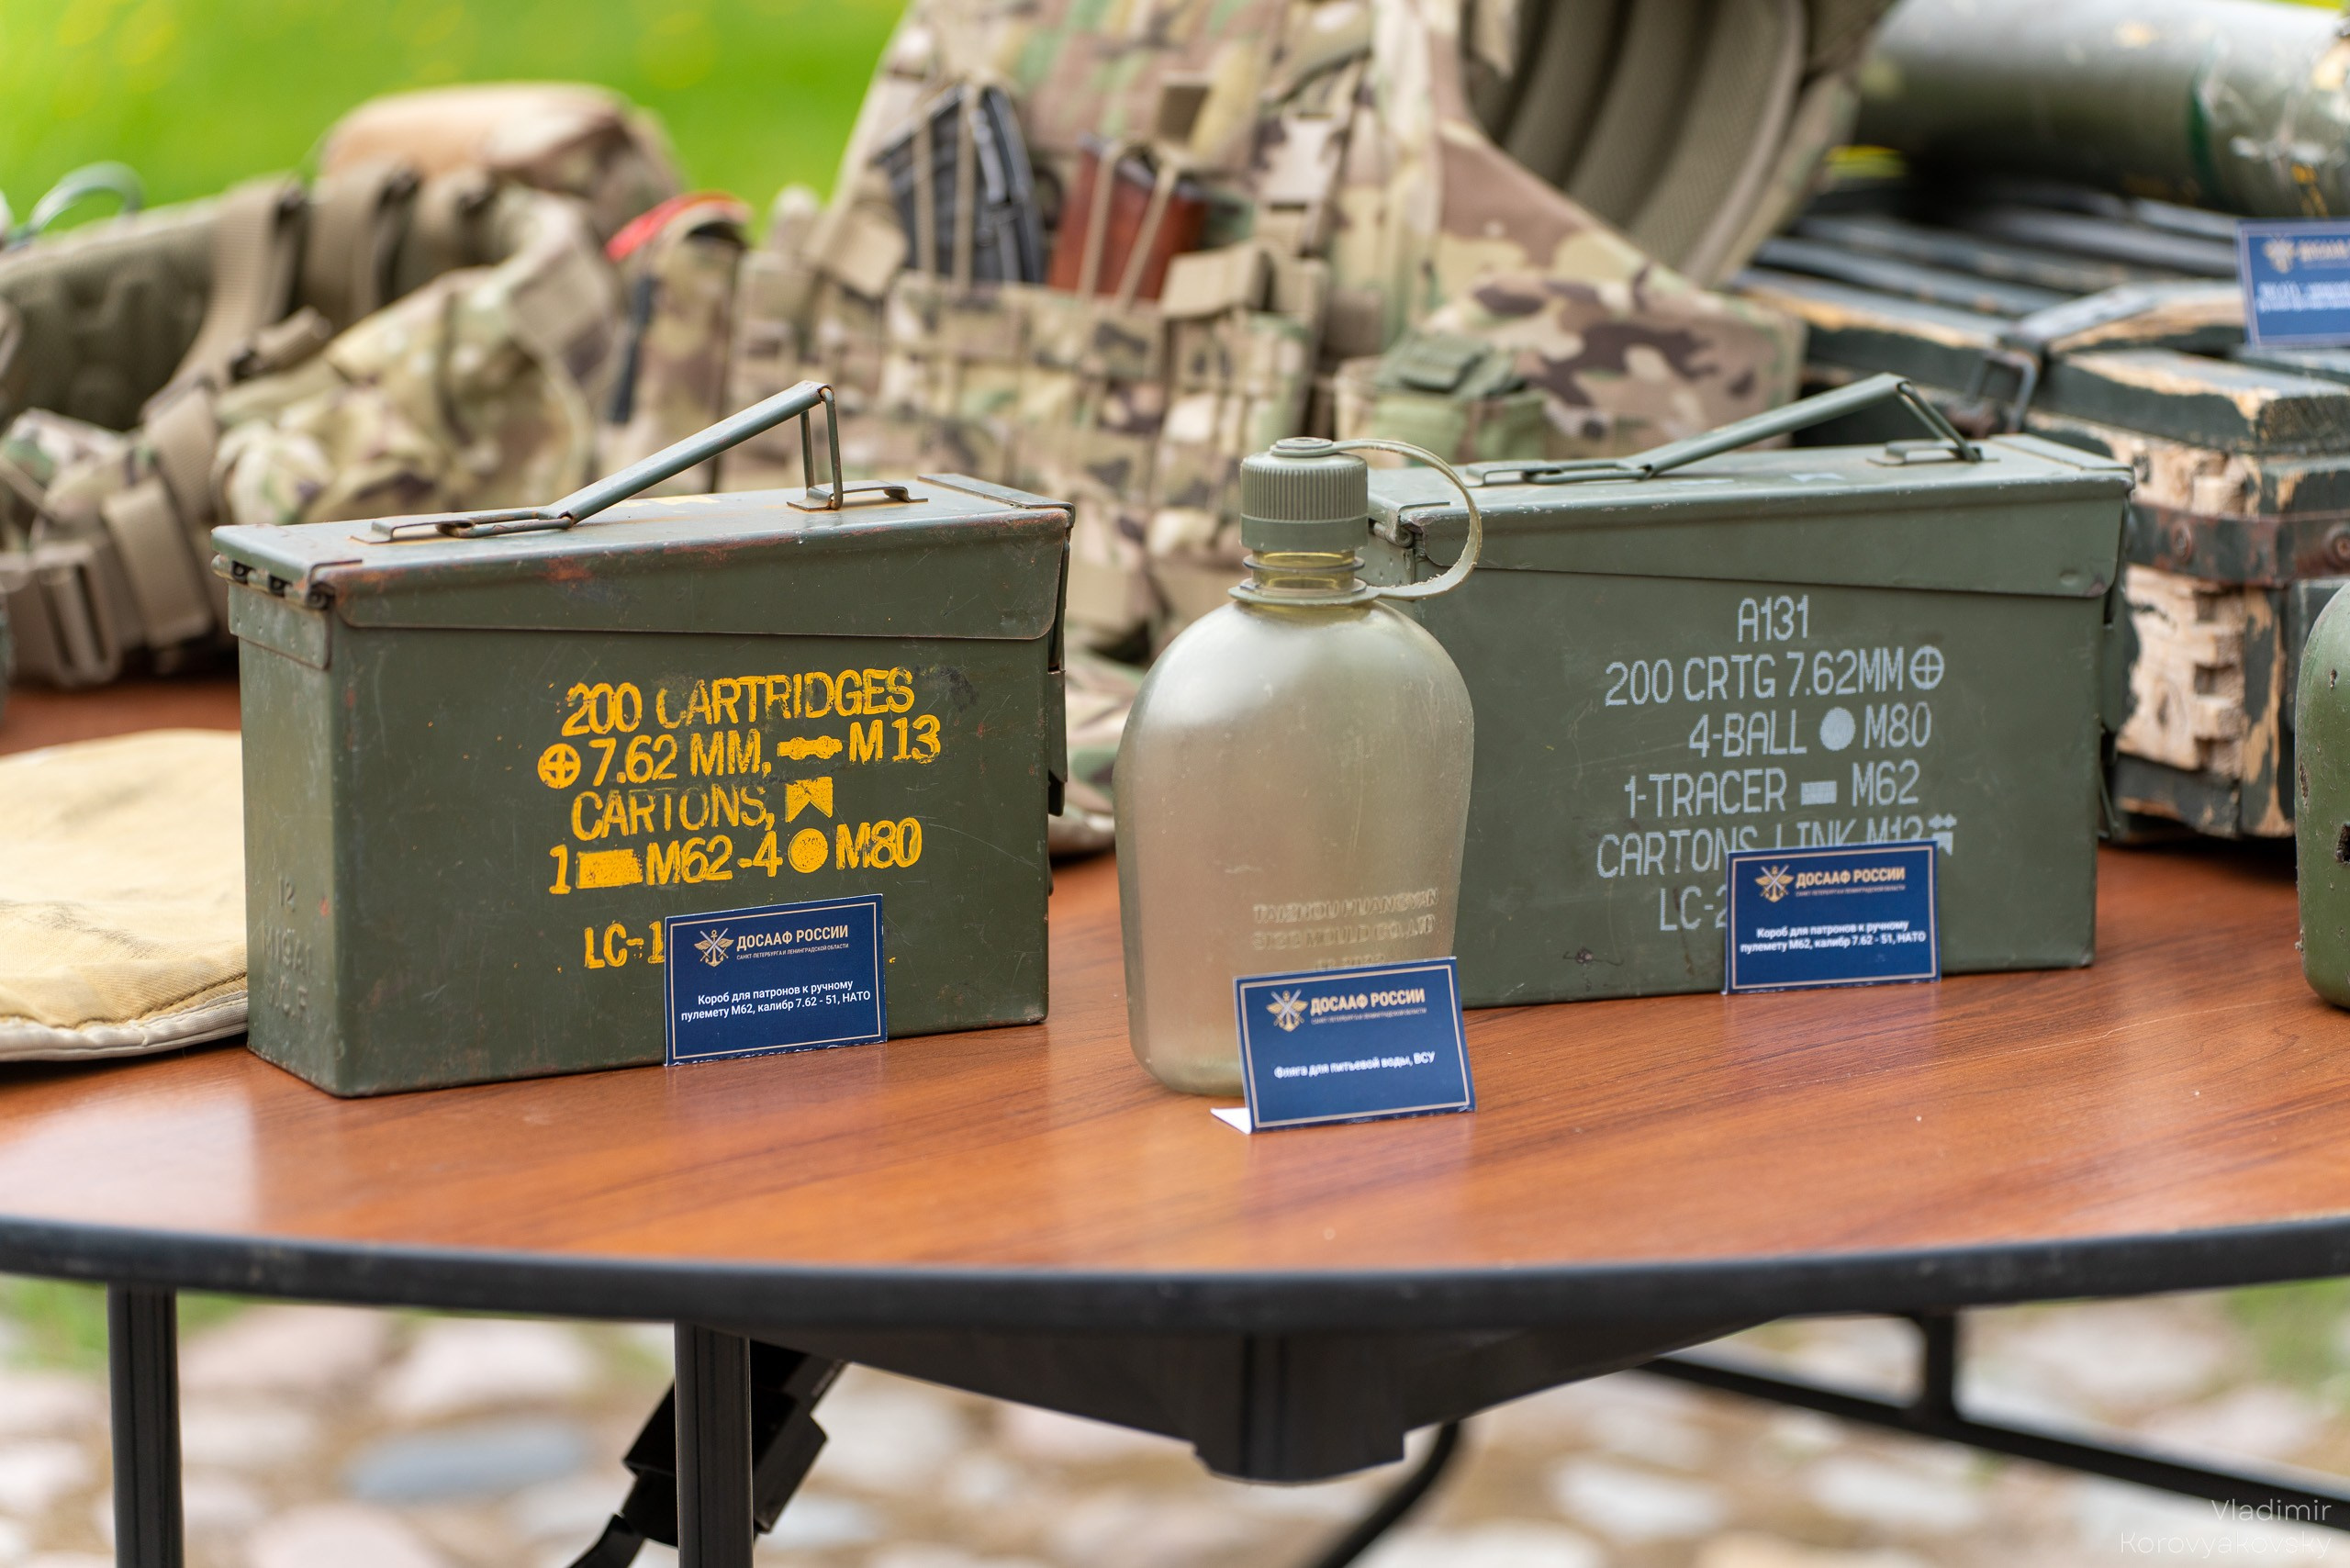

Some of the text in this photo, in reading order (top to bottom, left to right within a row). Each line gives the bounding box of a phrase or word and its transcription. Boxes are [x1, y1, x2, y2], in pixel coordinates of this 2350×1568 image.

[1738, 595, 1808, 643] A131
[1605, 647, 1904, 706] 200 CRTG 7.62MM
[562, 666, 916, 736] 200 CARTRIDGES
[1689, 701, 1931, 757] 4-BALL M80
[588, 734, 678, 787] 7.62
[690, 728, 772, 778] MM,
[1625, 759, 1919, 819] 1-TRACER M62
[571, 782, 776, 842] CARTONS,
[549, 844, 571, 894] 1
[836, 817, 923, 870] M80
[1796, 866, 1906, 889] ДОСААФ РОССИИ
[736, 924, 848, 952] ДОСААФ РОССИИ
[1740, 941, 1788, 955] пулемету
[1814, 935, 1851, 949] калибр
[1852, 935, 1873, 946] 7.62
[1881, 933, 1897, 945] 51,
[1897, 930, 1927, 943] НАТО
[1756, 921, 1910, 940] Короб для патронов к ручному
[681, 1007, 730, 1023] пулемету
[757, 999, 794, 1013] калибр
[796, 996, 818, 1008] 7.62
[825, 994, 840, 1006] 51,
[842, 991, 871, 1003] НАТО
[698, 980, 854, 1006] Короб для патронов к ручному
[1310, 993, 1369, 1016] ДОСААФ
[1370, 988, 1426, 1008] РОССИИ
[1274, 1051, 1436, 1079] Фляга для питьевой воды, ВСУ
